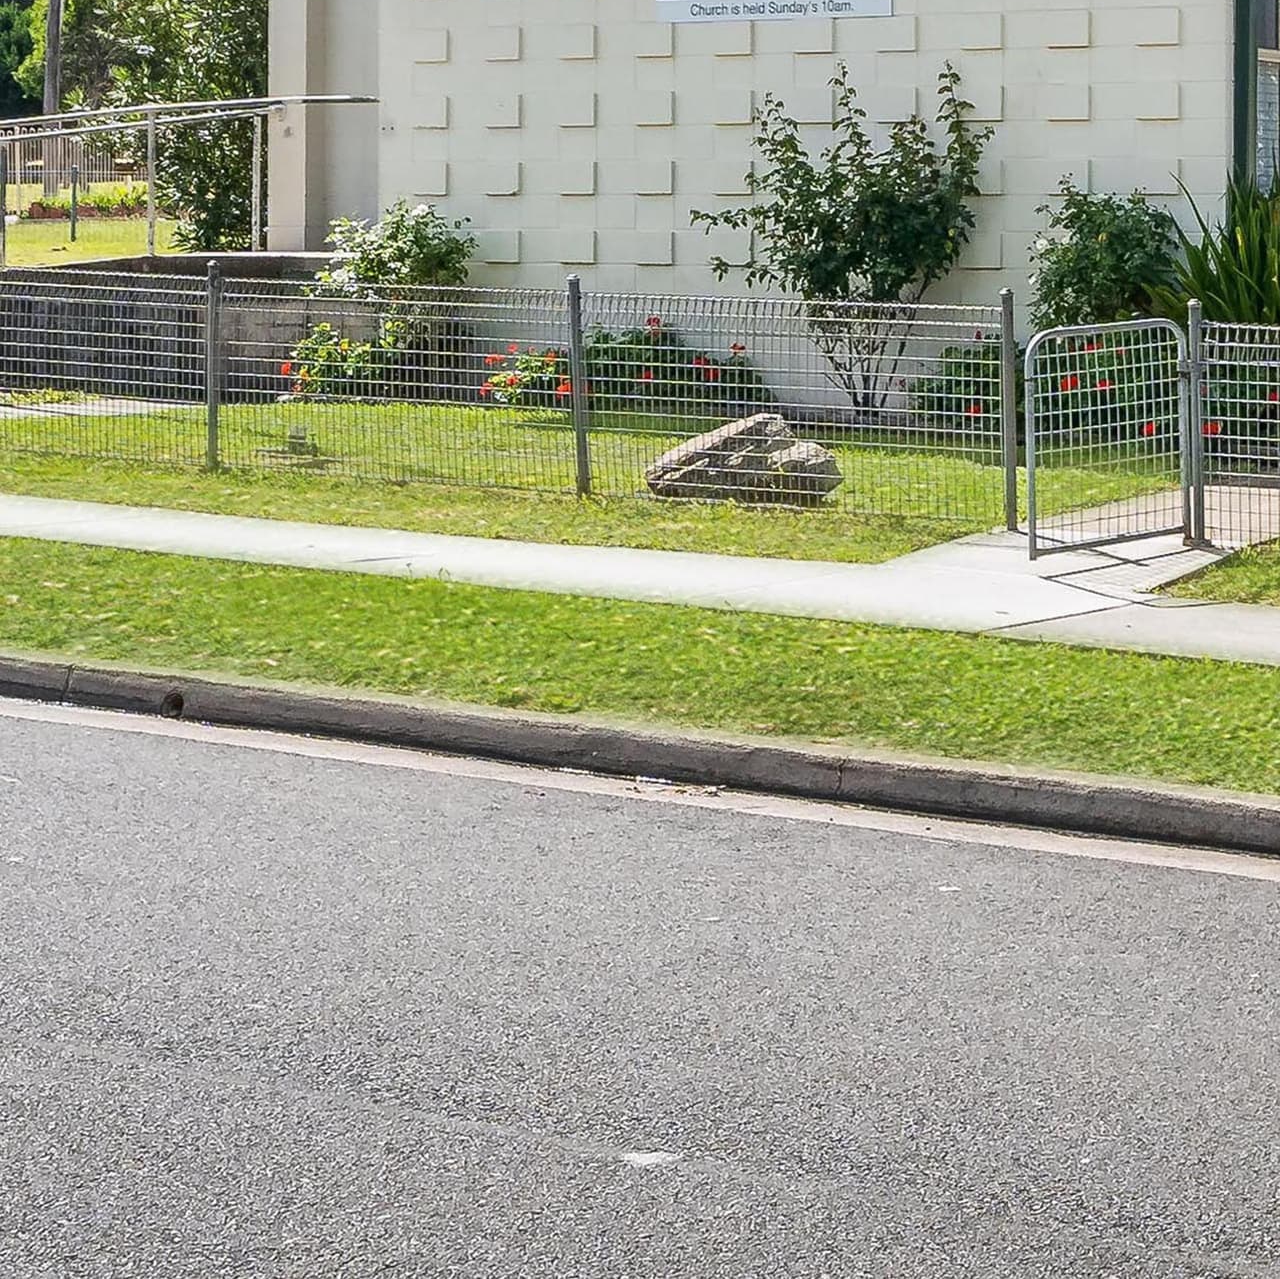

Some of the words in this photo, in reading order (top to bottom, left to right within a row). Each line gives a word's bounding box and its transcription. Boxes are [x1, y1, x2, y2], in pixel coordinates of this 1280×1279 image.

[690, 3, 728, 17] Church
[731, 3, 741, 16] is
[742, 2, 766, 15] held
[768, 1, 818, 17] Sunday's
[822, 0, 854, 13] 10am.
